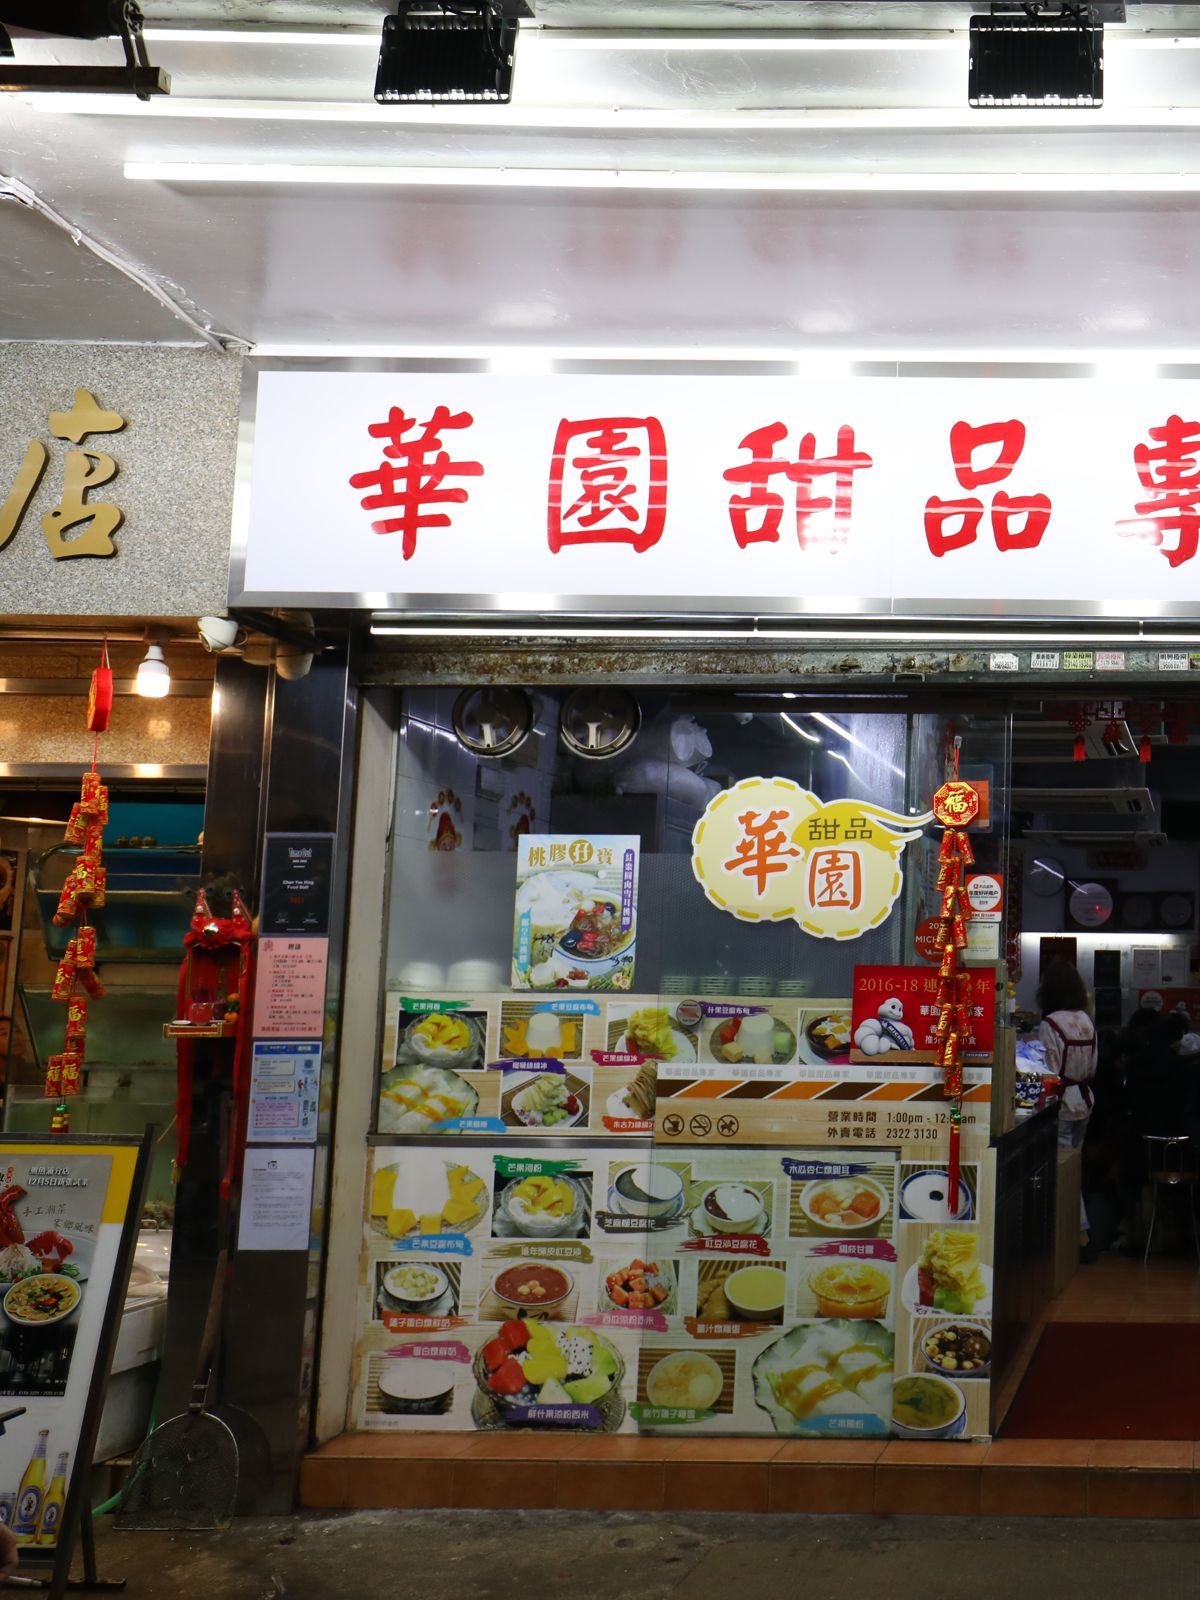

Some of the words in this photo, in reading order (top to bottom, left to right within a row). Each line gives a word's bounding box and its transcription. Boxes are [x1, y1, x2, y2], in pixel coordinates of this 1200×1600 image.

[944, 790, 968, 813] 福
[809, 818, 872, 841] 甜品
[725, 810, 861, 911] 華園
[859, 978, 918, 991] 2016-18
[923, 977, 990, 994] 連年
[925, 1036, 977, 1046] 推介小食
[828, 1110, 877, 1124] 營業時間
[887, 1112, 923, 1126] 1:00pm
[935, 1112, 976, 1124] 12:am
[828, 1126, 876, 1139] 外賣電話
[886, 1127, 910, 1139] 2322
[912, 1128, 938, 1140] 3130
